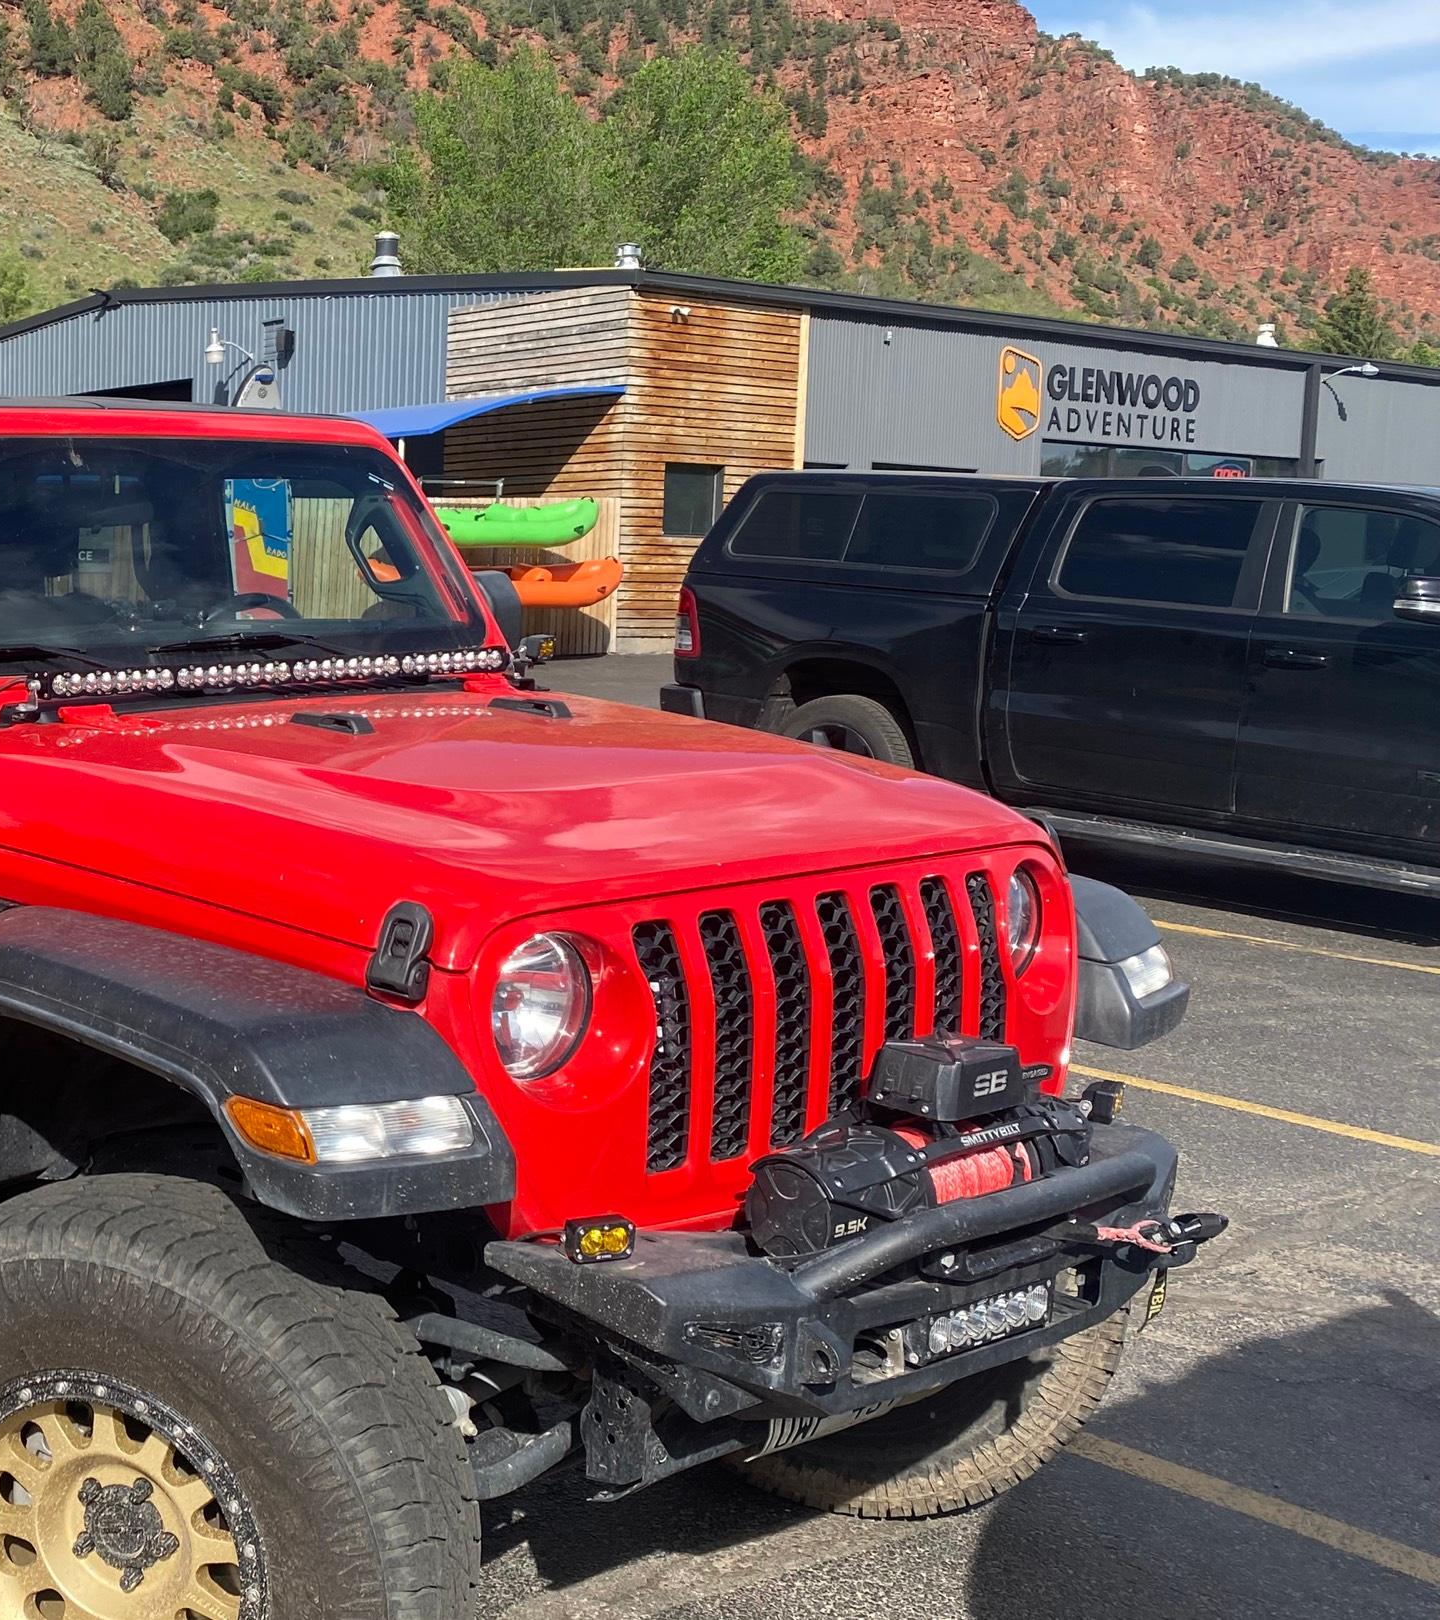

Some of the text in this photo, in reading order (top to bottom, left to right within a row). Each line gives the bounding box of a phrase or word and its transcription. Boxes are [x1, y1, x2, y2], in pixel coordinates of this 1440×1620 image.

[1047, 364, 1200, 412] GLENWOOD
[1047, 406, 1196, 443] ADVENTURE
[266, 545, 287, 558] RADO
[960, 1122, 1021, 1148] SMITTYBILT
[833, 1216, 869, 1239] 9.5K
